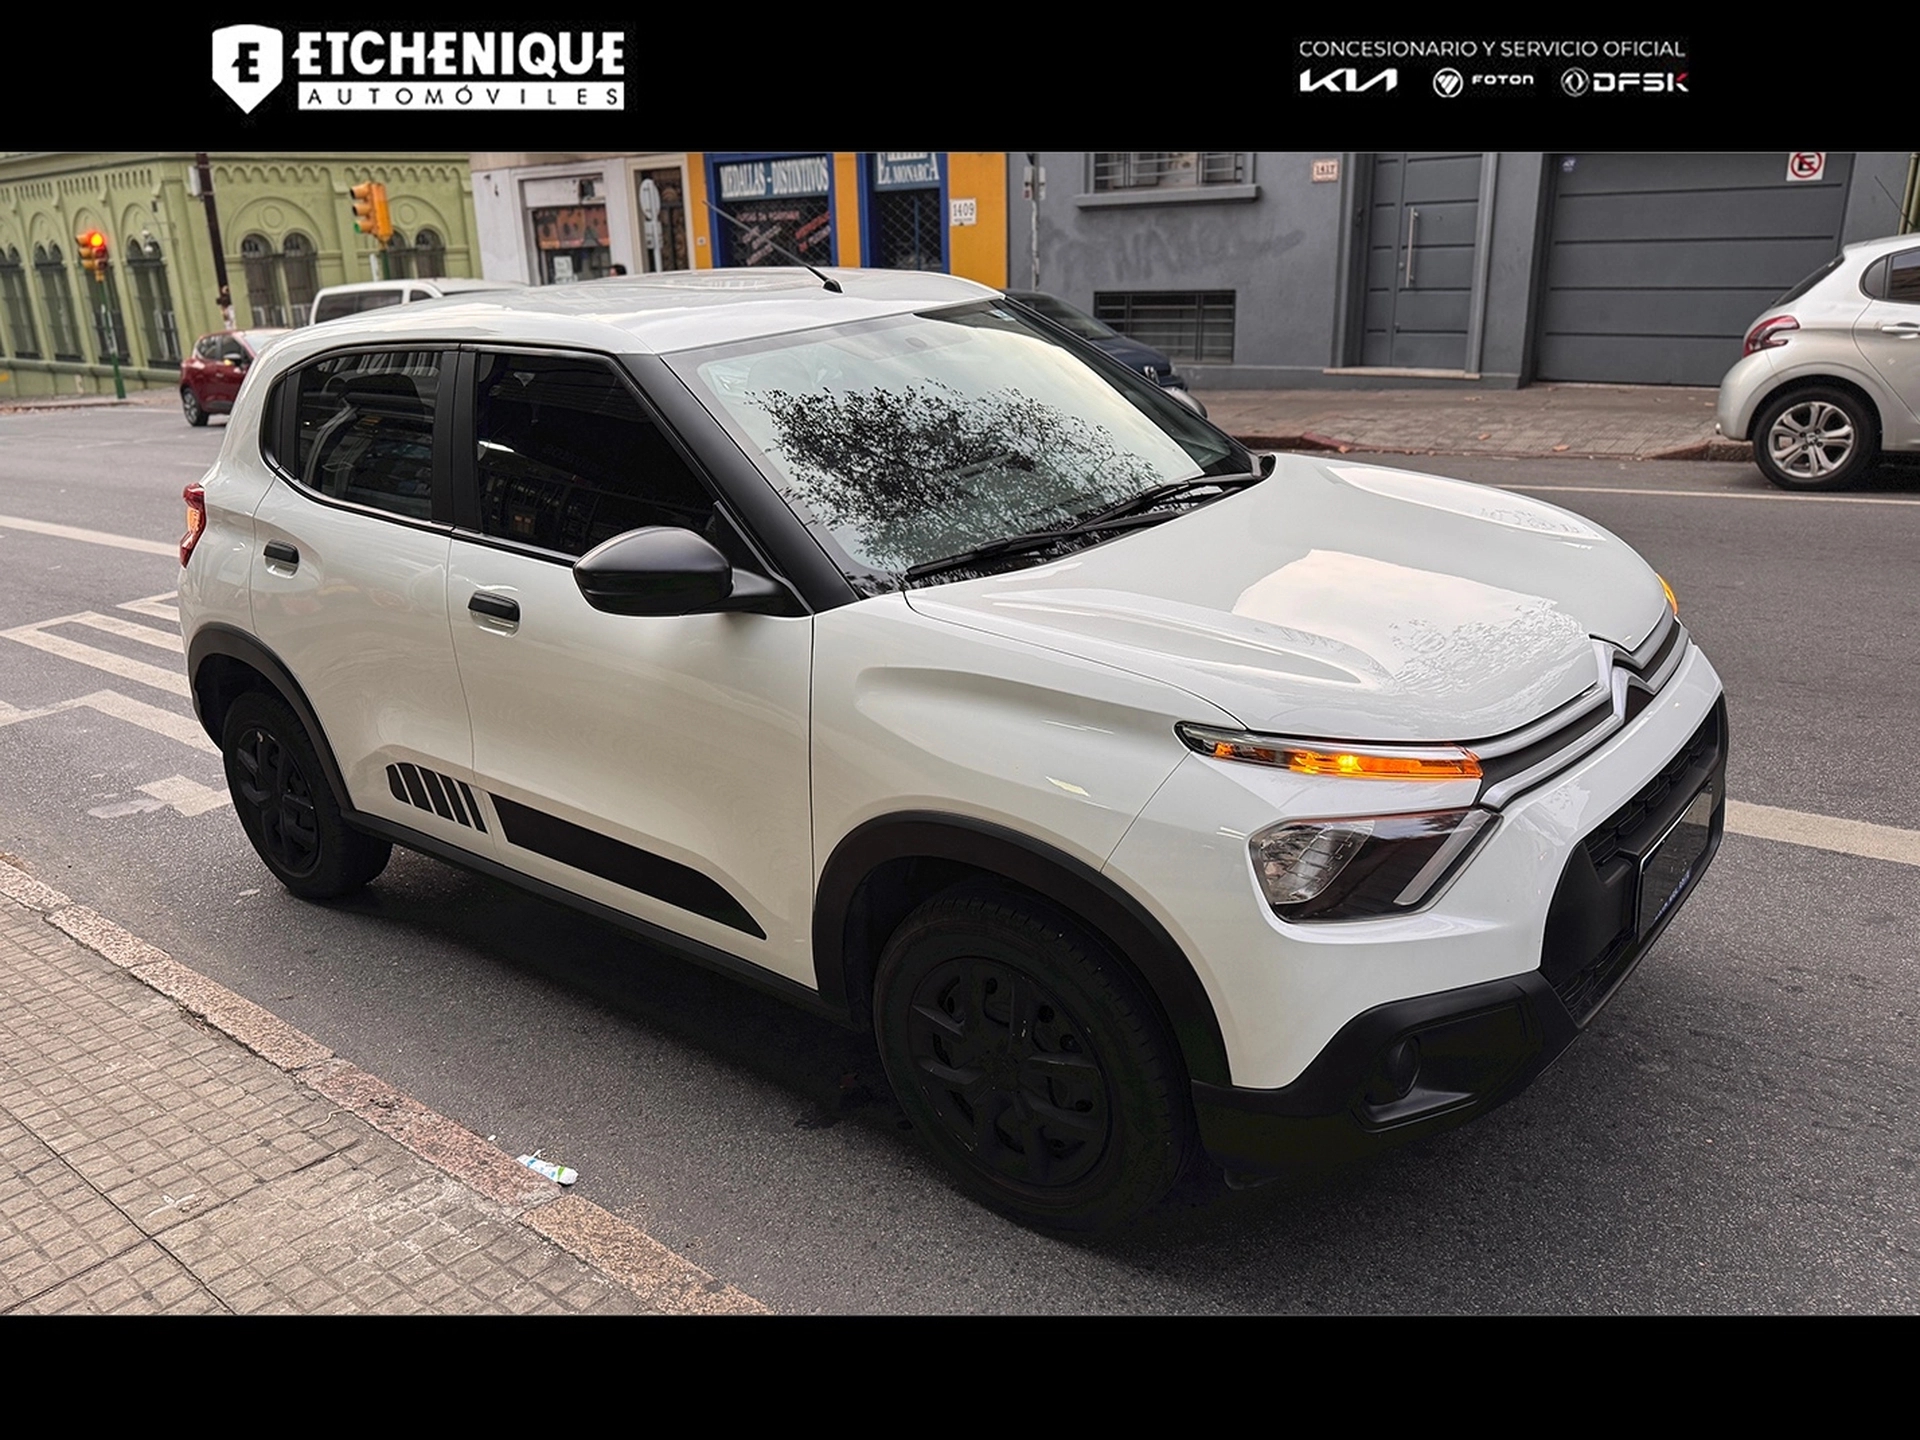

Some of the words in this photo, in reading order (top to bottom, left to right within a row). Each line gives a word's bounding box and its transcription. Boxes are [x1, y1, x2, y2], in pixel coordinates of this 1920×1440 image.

[720, 162, 766, 198] MEDALLAS
[771, 156, 829, 195] DISTINTIVOS
[893, 153, 940, 183] MONARCA
[953, 202, 974, 217] 1409
